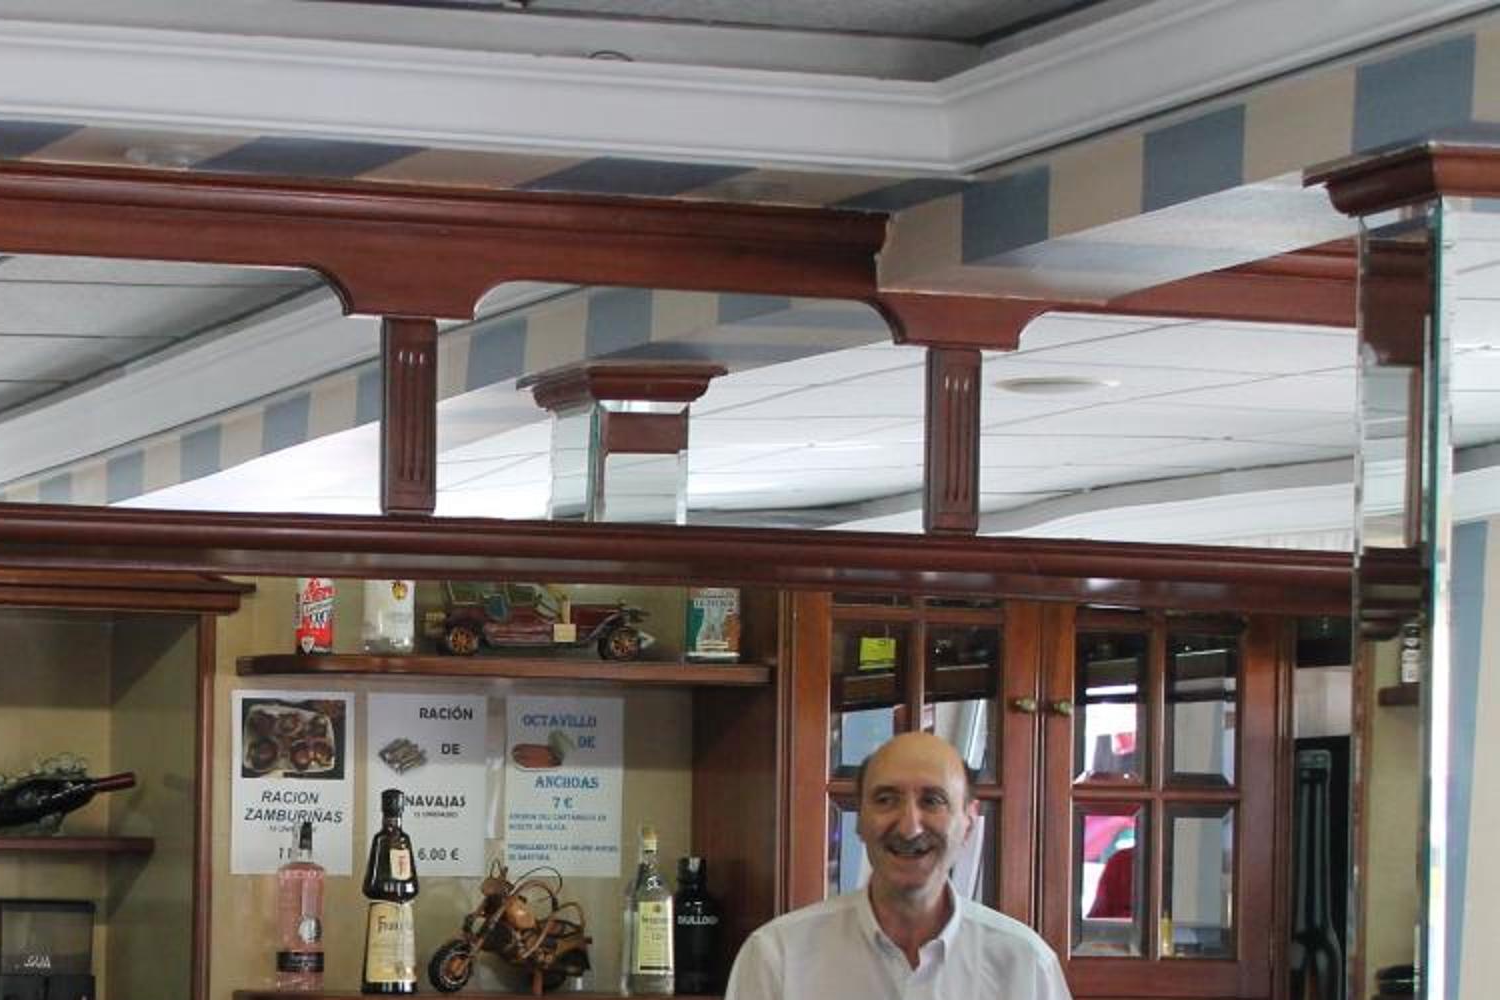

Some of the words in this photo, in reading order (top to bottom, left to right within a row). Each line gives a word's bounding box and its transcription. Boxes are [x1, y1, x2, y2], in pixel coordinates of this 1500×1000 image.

[419, 705, 474, 721] RACIÓN
[522, 713, 597, 728] OCTAVILLO
[440, 743, 461, 755] DE
[578, 735, 596, 749] DE
[534, 775, 599, 789] ANCHOAS
[261, 790, 320, 805] RACION
[403, 794, 467, 808] NAVAJAS
[553, 797, 560, 808] 7
[417, 848, 447, 861] 6.00
[450, 848, 460, 861] €
